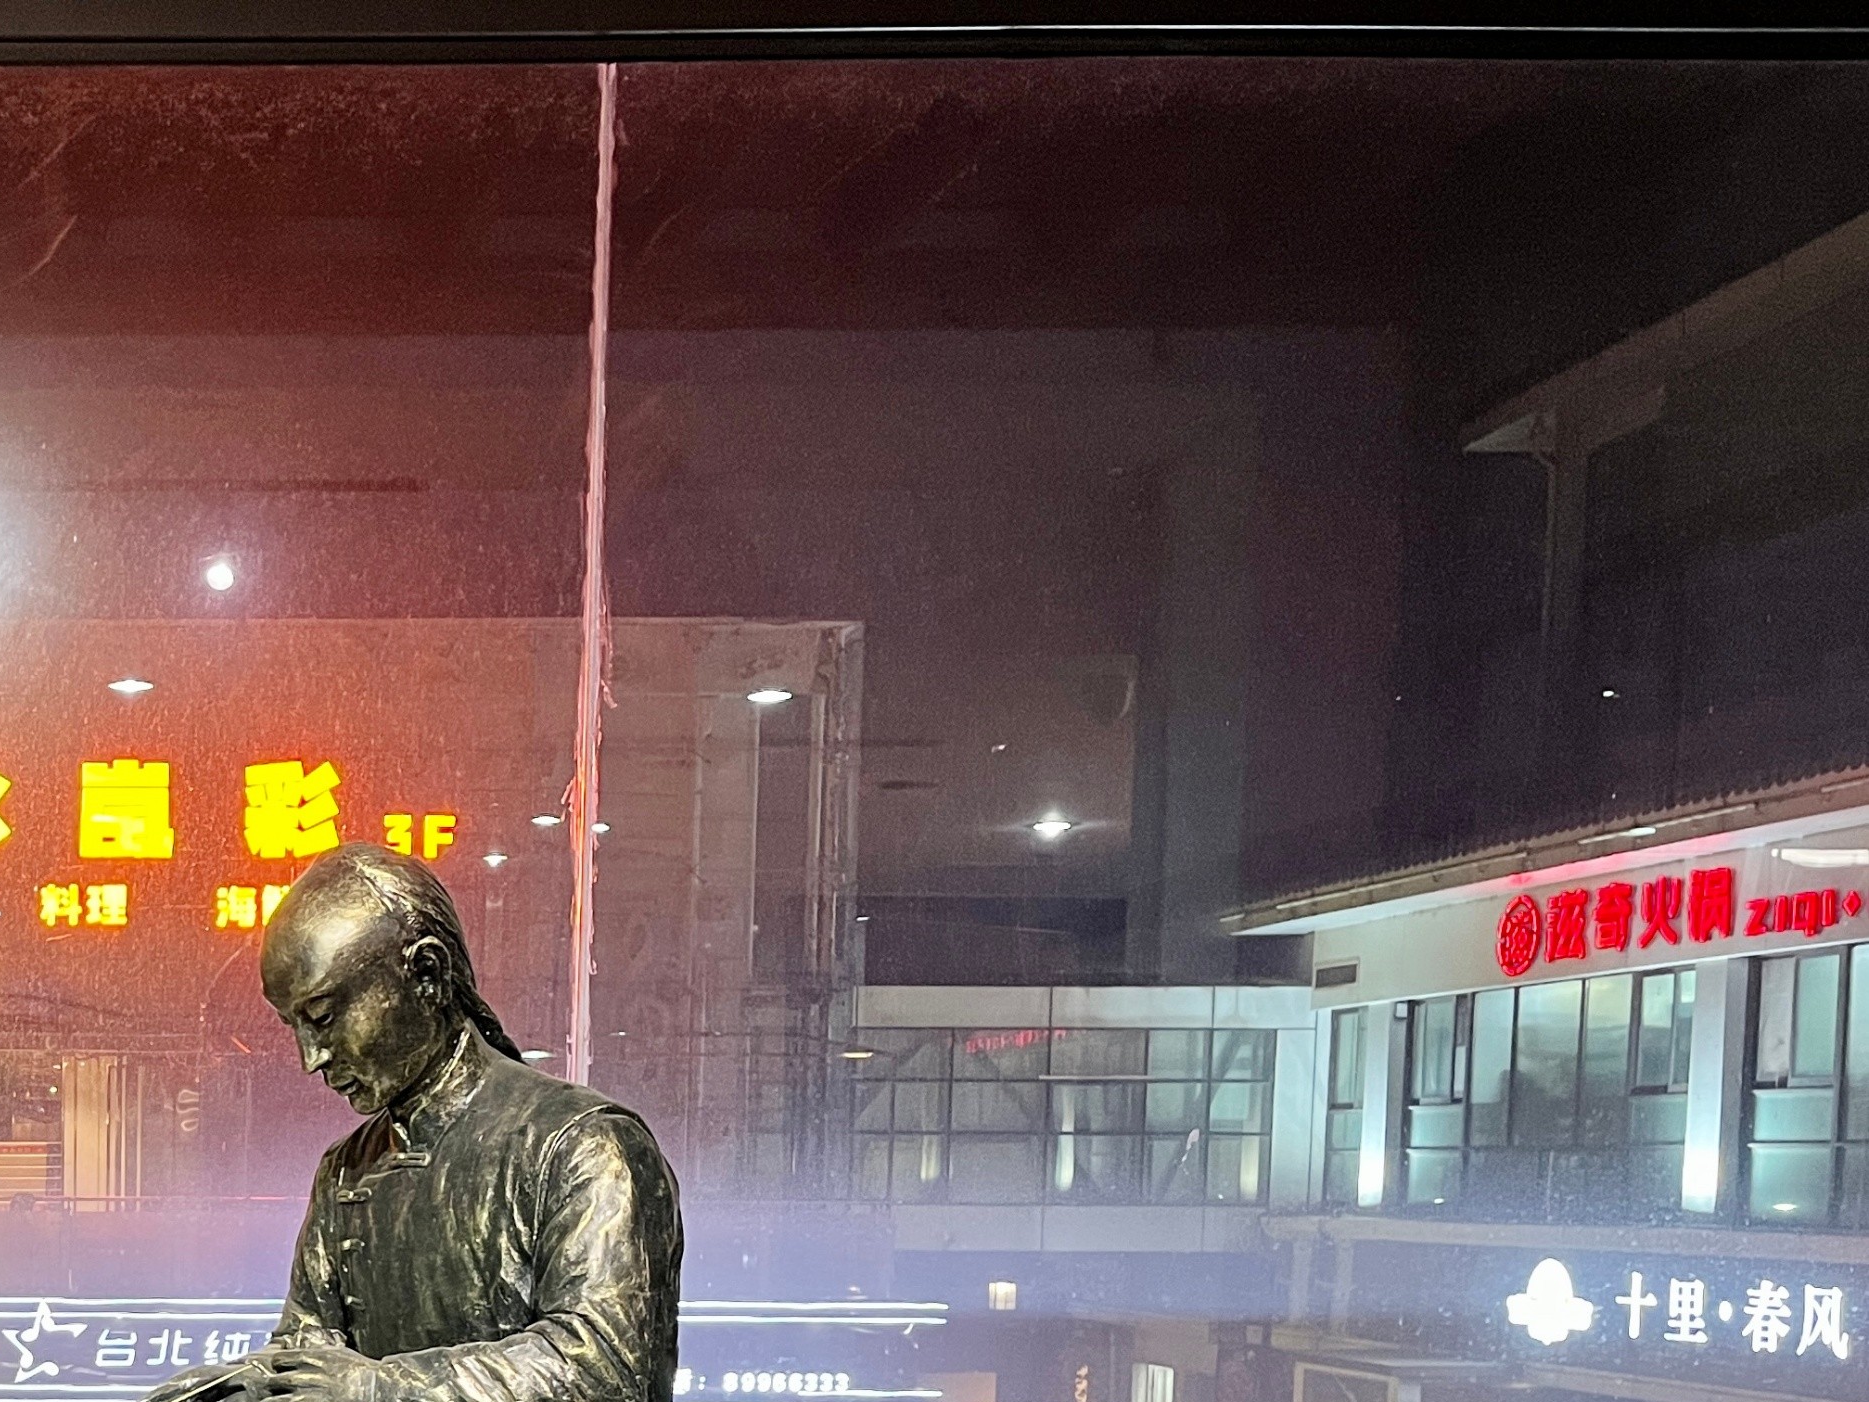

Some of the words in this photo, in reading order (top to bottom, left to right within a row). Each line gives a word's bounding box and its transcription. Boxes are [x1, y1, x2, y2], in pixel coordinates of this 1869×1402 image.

[383, 814, 456, 860] 3F
[39, 884, 128, 926] 料理
[95, 1328, 273, 1367] 台北纯
